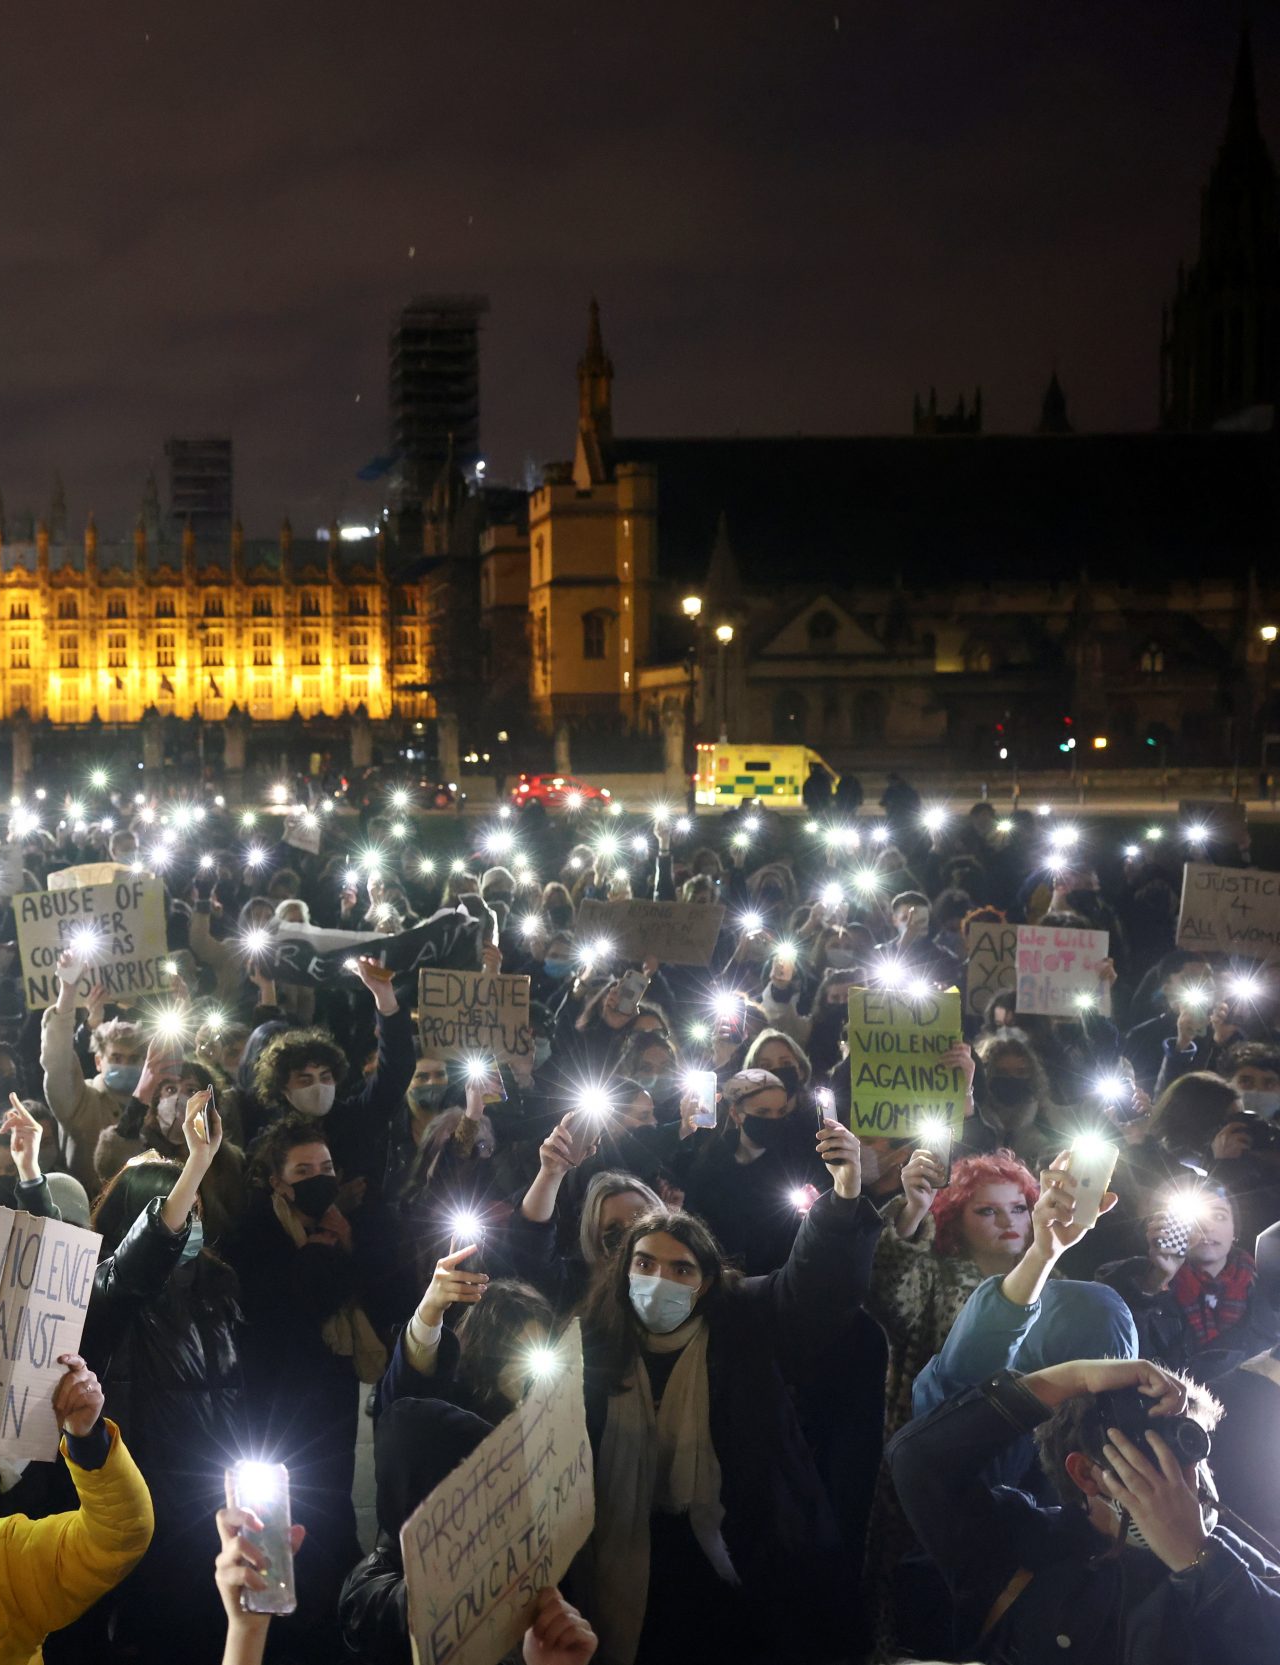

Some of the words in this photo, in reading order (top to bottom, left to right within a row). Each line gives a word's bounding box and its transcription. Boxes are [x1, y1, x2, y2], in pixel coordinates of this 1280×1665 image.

[1194, 871, 1280, 896] JUSTIC
[22, 887, 94, 924] ABUSE
[115, 881, 144, 911] OF
[1230, 895, 1252, 919] 4
[1183, 916, 1217, 939] ALL
[112, 933, 135, 955] AS
[970, 929, 1017, 962] AR
[423, 971, 531, 1009] EDUCATE
[863, 992, 940, 1027] END
[855, 1062, 962, 1093] AGAINST
[429, 1503, 550, 1665] EDUCATE
